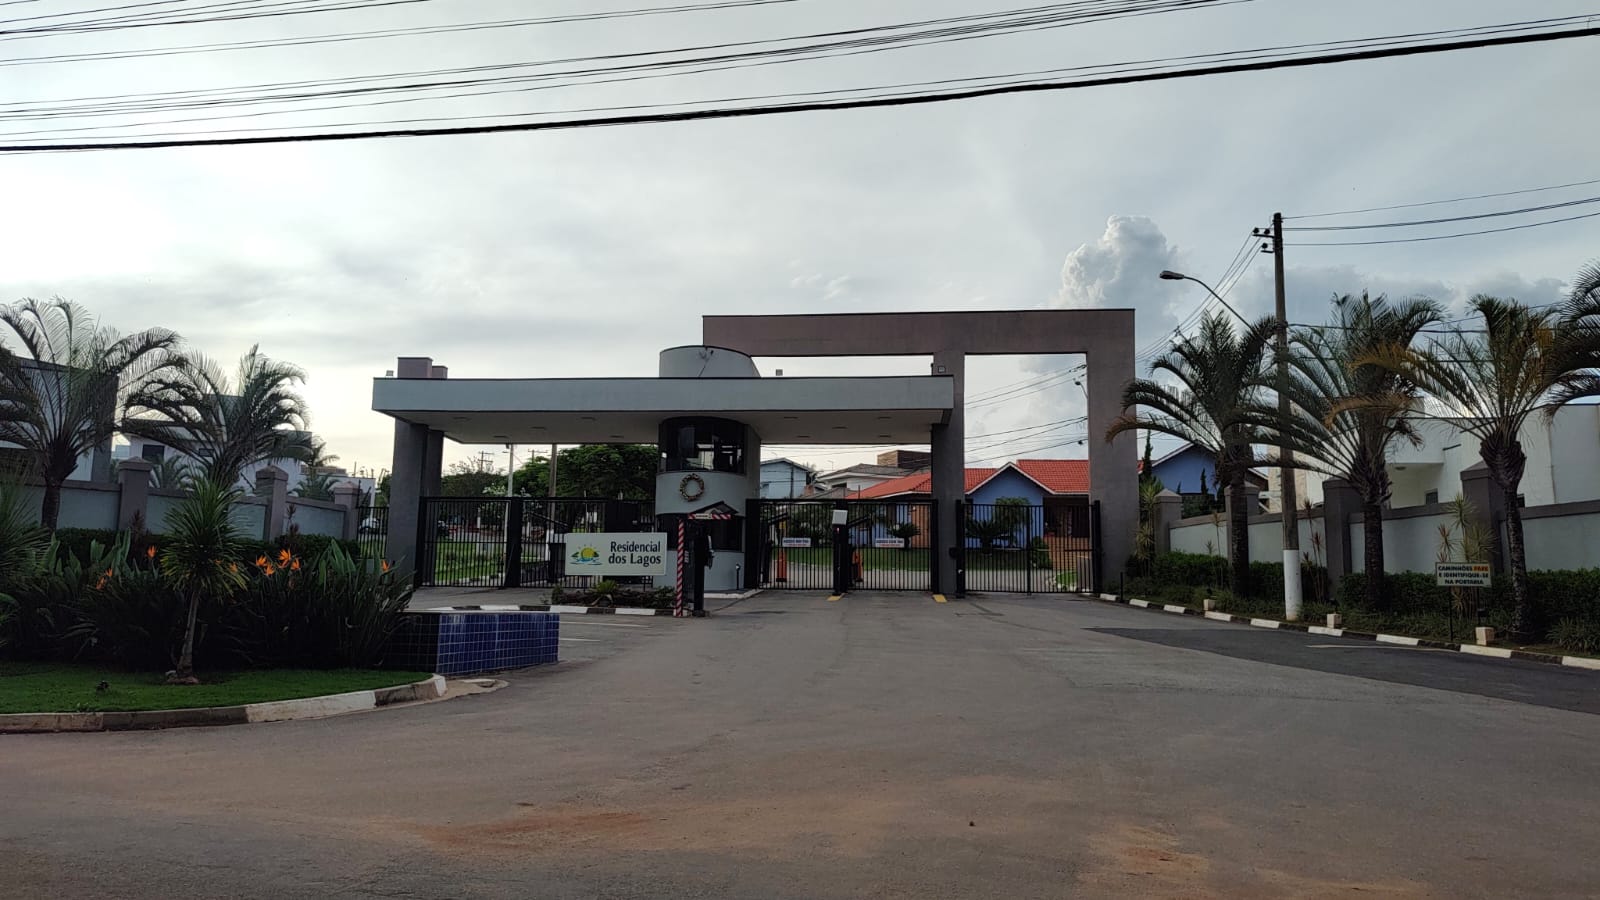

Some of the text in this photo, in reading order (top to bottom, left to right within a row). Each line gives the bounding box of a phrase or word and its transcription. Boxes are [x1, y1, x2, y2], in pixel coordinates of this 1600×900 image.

[610, 541, 661, 553] Residencial
[608, 553, 661, 567] dos Lagos
